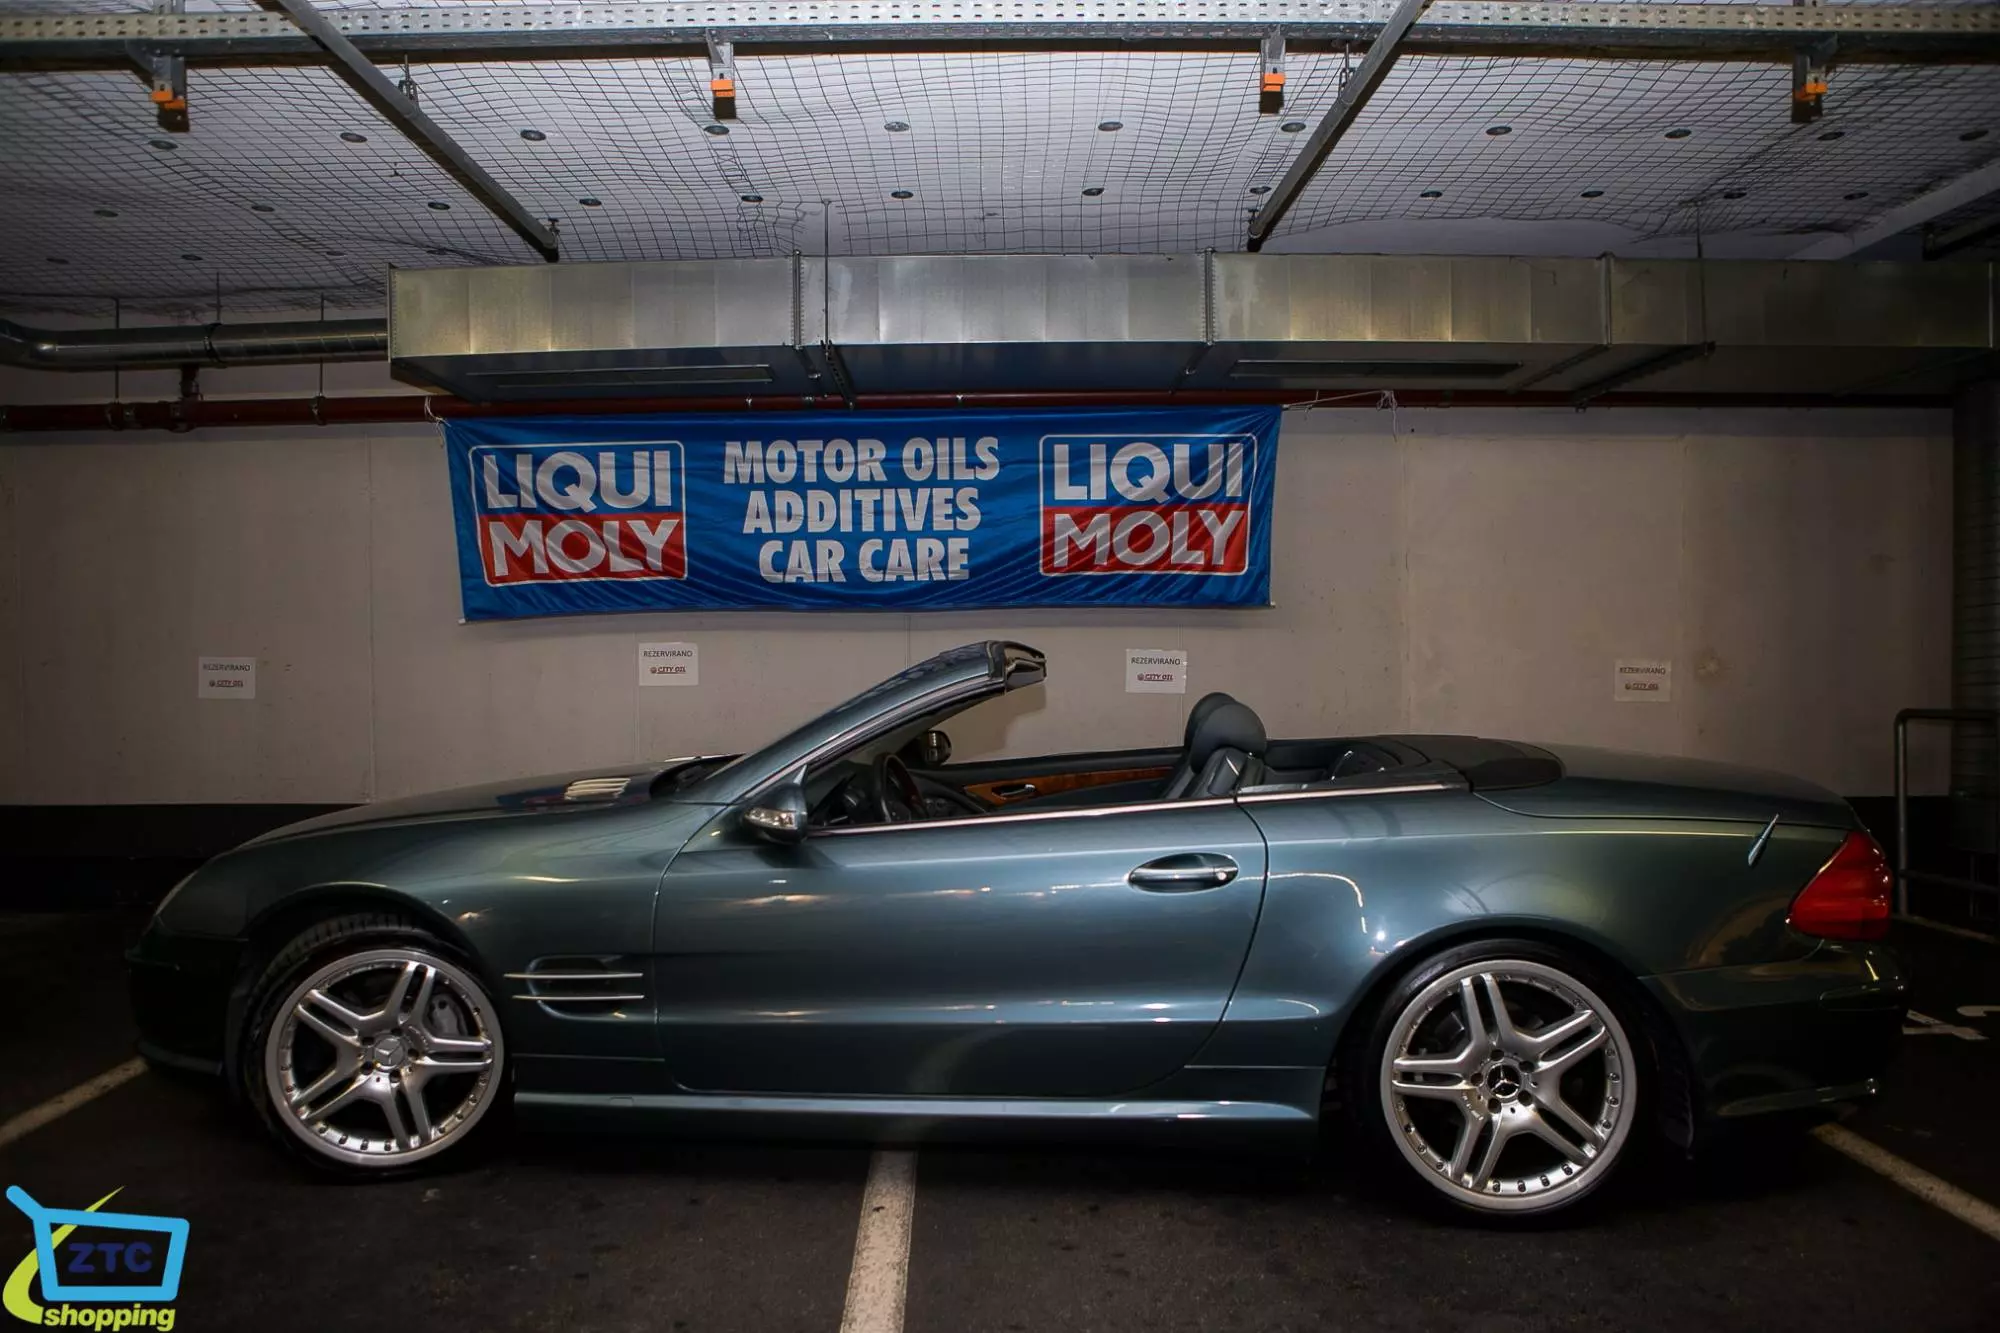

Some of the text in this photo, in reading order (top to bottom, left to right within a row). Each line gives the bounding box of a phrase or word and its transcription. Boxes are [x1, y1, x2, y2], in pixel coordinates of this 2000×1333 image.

[483, 449, 671, 513] LIQUI
[724, 436, 1000, 485] MOTOR OILS
[1053, 440, 1245, 504] LIQUI
[742, 487, 982, 535] ADDITIVES
[488, 518, 681, 578] MOLY
[758, 537, 970, 584] CAR CARE
[1053, 508, 1246, 568] MOLY
[642, 650, 693, 658] REZERVIRANO
[1130, 656, 1181, 666] REZERVIRANO
